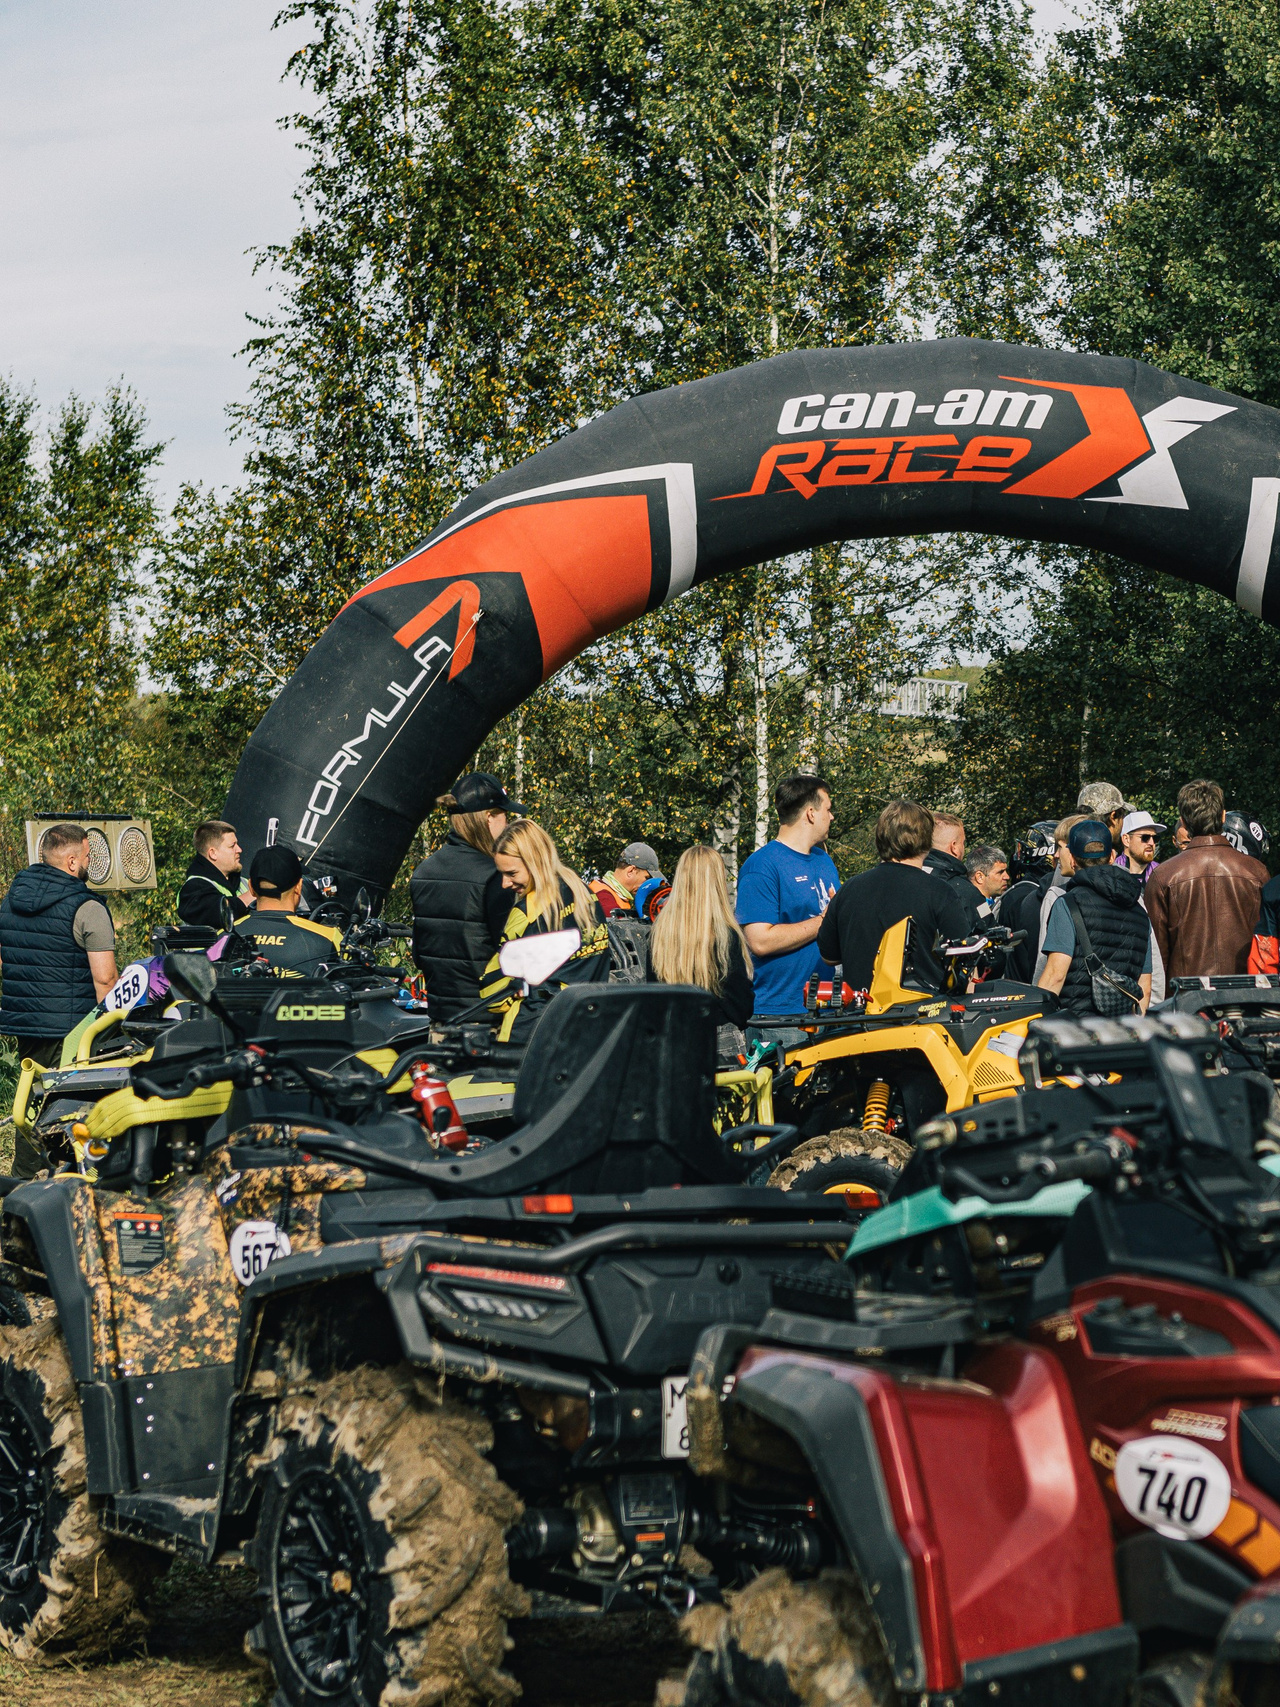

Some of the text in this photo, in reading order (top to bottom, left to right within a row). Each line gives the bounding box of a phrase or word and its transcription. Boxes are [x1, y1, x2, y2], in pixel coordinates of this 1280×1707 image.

[776, 388, 1054, 435] can-am
[296, 636, 452, 847] FORMULA
[114, 973, 141, 1010] 558
[242, 1243, 280, 1279] 567
[1138, 1465, 1207, 1523] 740
